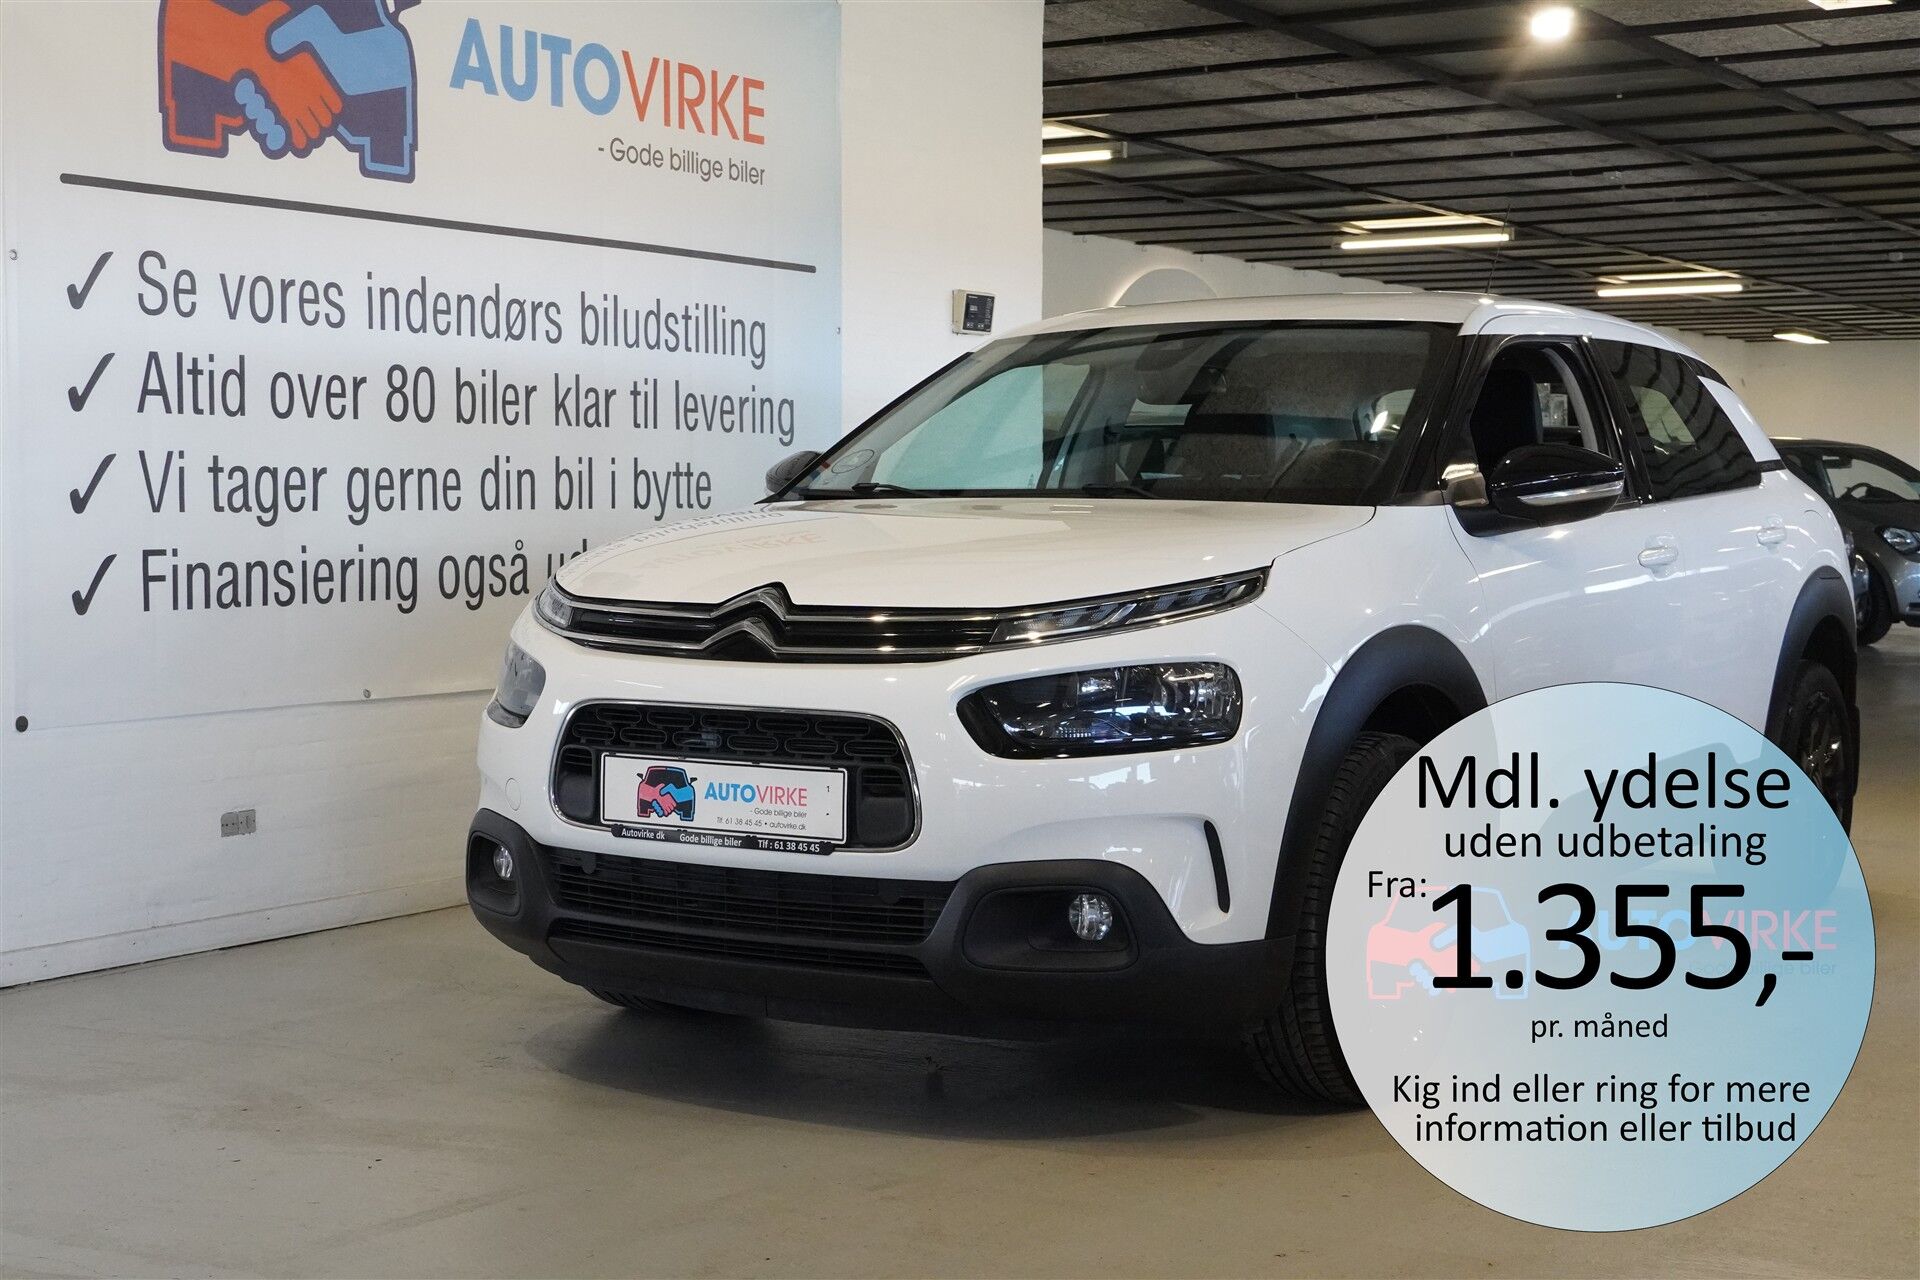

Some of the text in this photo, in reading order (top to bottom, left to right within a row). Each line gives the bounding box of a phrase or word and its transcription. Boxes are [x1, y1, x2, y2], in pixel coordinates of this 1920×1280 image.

[449, 17, 765, 145] AUTOVIRKE
[610, 137, 664, 168] Gode
[669, 148, 723, 182] billige
[728, 158, 765, 185] biler
[138, 251, 766, 369] Se vores indendørs biludstilling
[137, 352, 795, 446] Altid over 80 biler klar til levering
[138, 451, 712, 527] Vi tager gerne din bil i bytte
[142, 544, 418, 615] Finansiering
[438, 540, 530, 611] også
[704, 782, 808, 807] AUTOVIRKE
[734, 818, 743, 826] 38
[744, 818, 753, 827] 45
[754, 819, 763, 827] 45
[753, 807, 773, 816] Gode
[773, 808, 793, 818] billige
[793, 810, 808, 818] biler
[621, 828, 655, 840] Autovirke
[655, 830, 666, 841] dk
[679, 833, 699, 843] Gode
[700, 834, 723, 847] billige
[724, 837, 742, 848] biler
[774, 841, 784, 850] 61
[785, 841, 797, 851] 38
[797, 842, 808, 852] 45
[809, 843, 820, 853] 45
